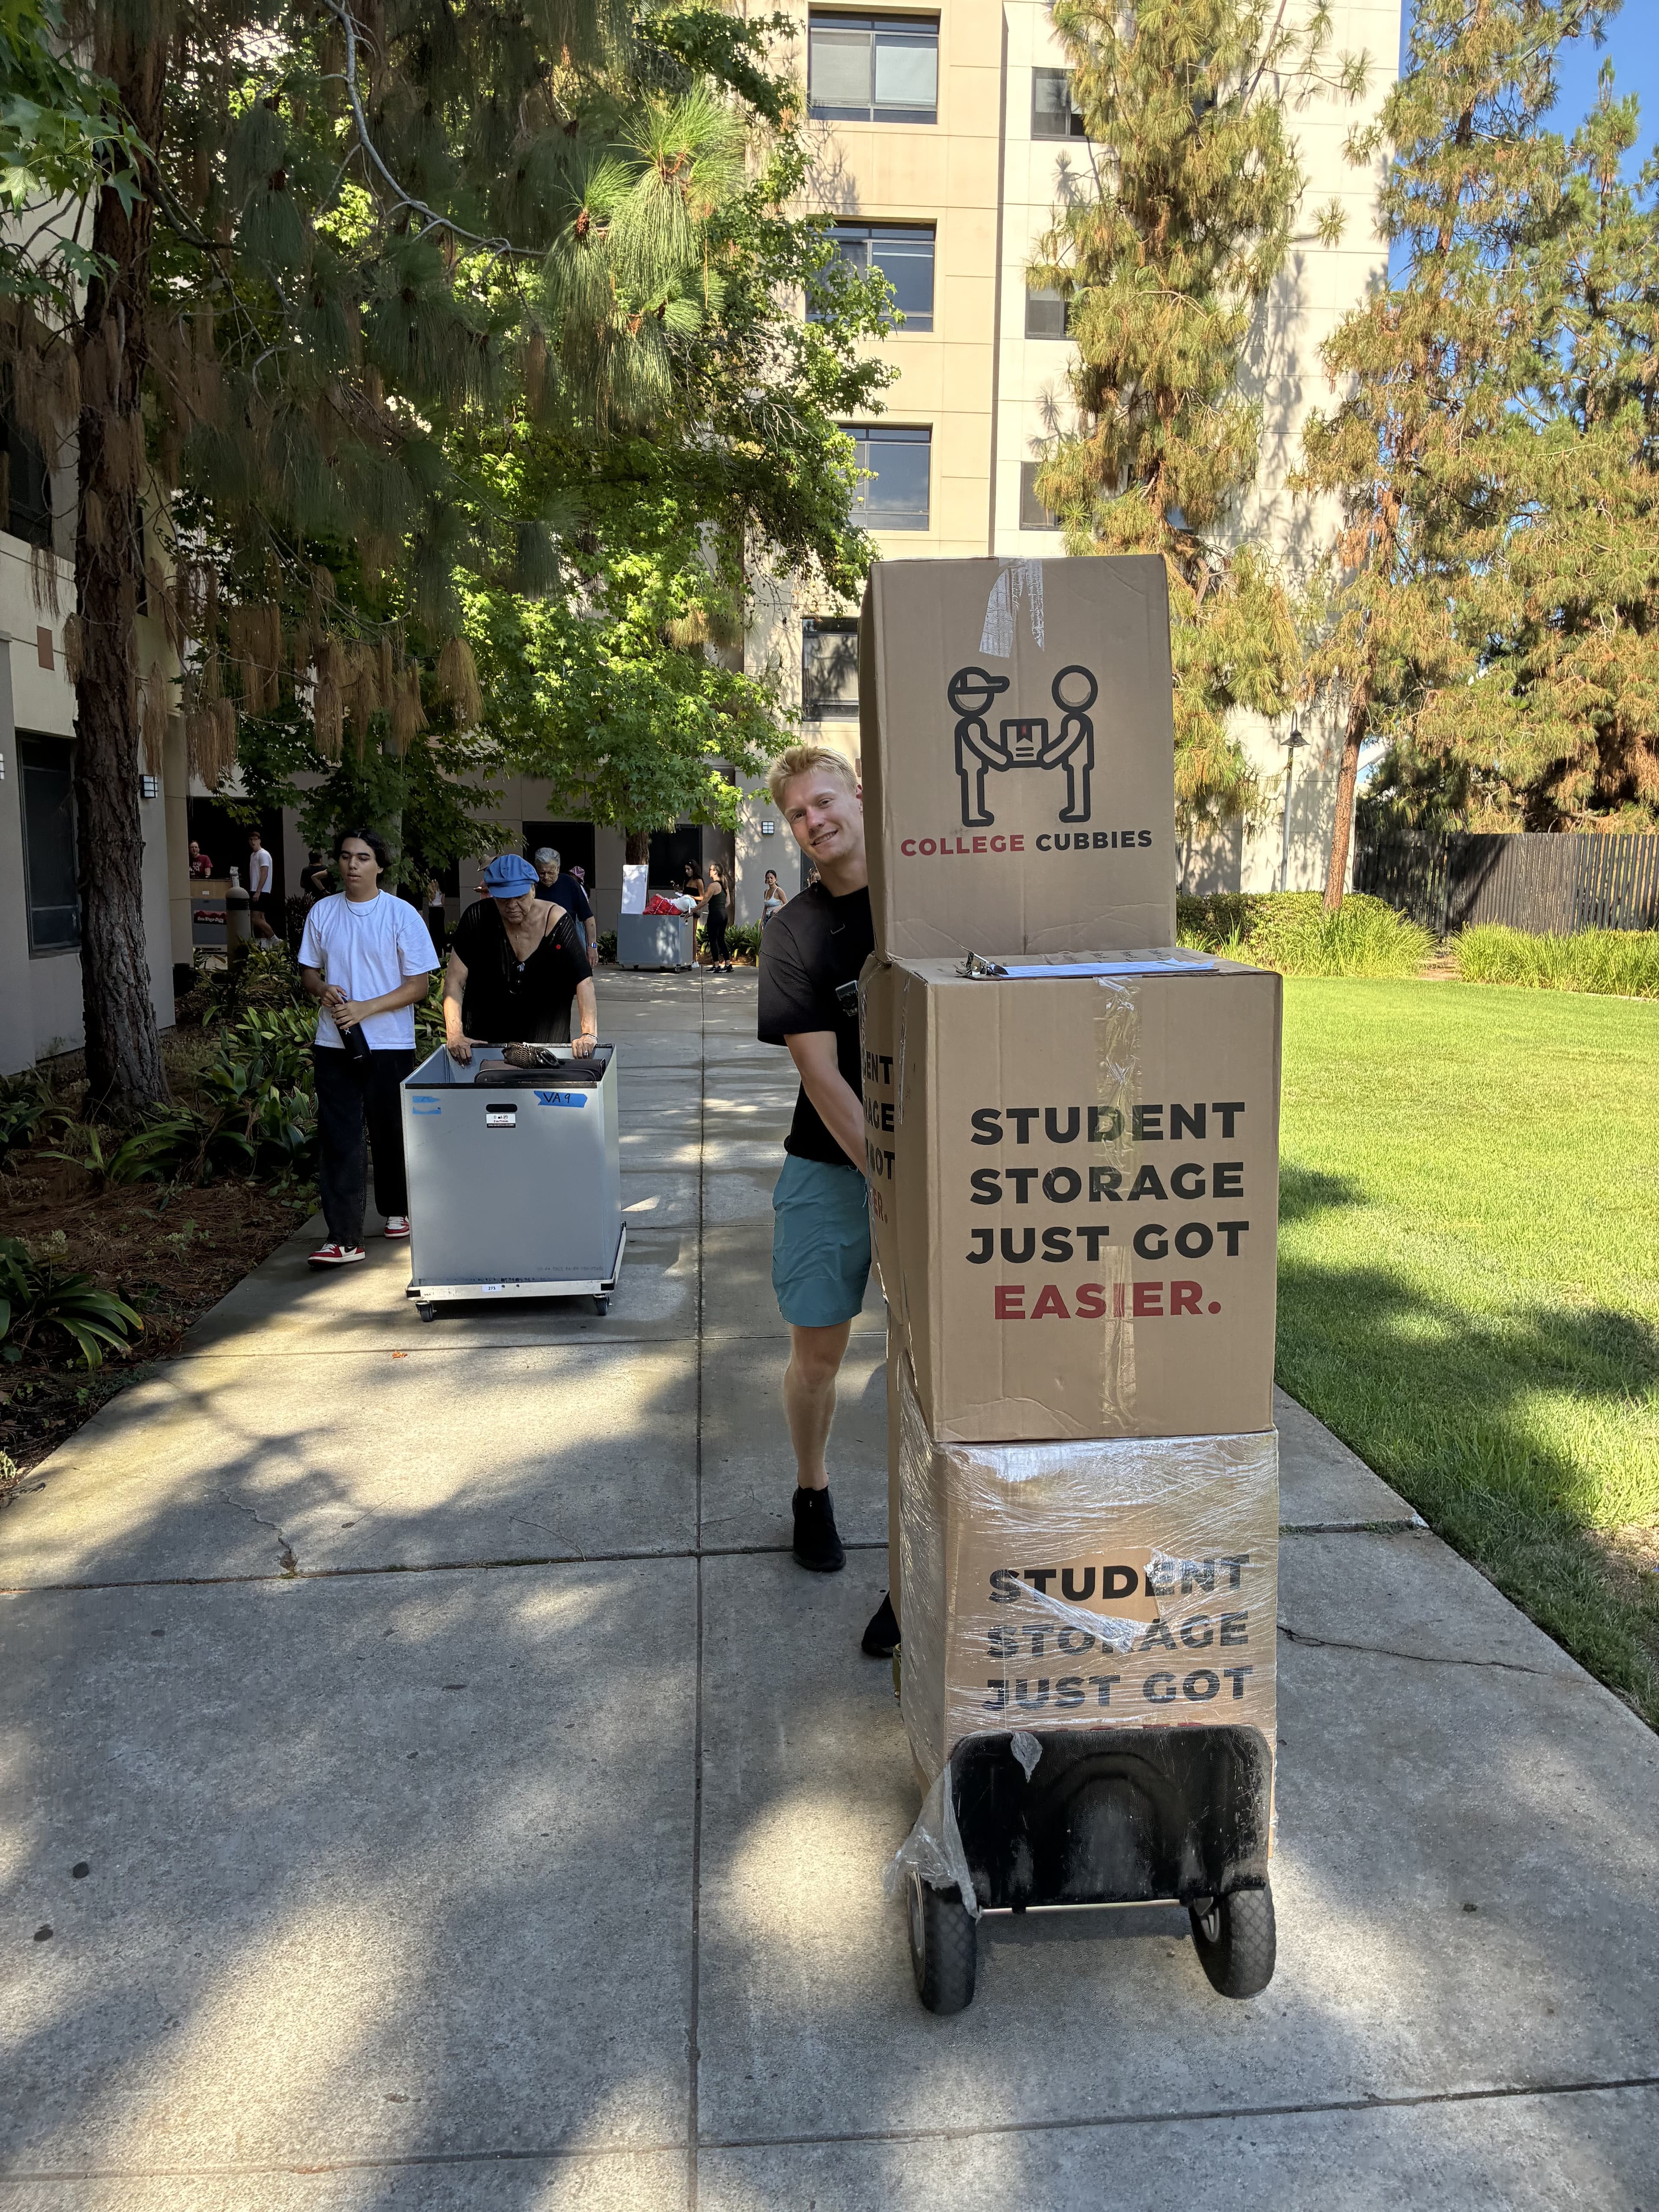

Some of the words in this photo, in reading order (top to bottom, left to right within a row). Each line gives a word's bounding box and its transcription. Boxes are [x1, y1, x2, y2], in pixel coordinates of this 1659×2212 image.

[900, 834, 1024, 857] COLLEGE
[1036, 830, 1152, 852] CUBBIES
[543, 1092, 561, 1103] VA
[970, 1102, 1245, 1145] STUDENT
[969, 1162, 1244, 1205] STORAGE
[965, 1225, 1109, 1265] JUST
[1133, 1221, 1249, 1260] GOT
[995, 1280, 1222, 1320] EASIER.
[981, 1672, 1120, 1712] JUST
[1142, 1665, 1253, 1705] GOT
